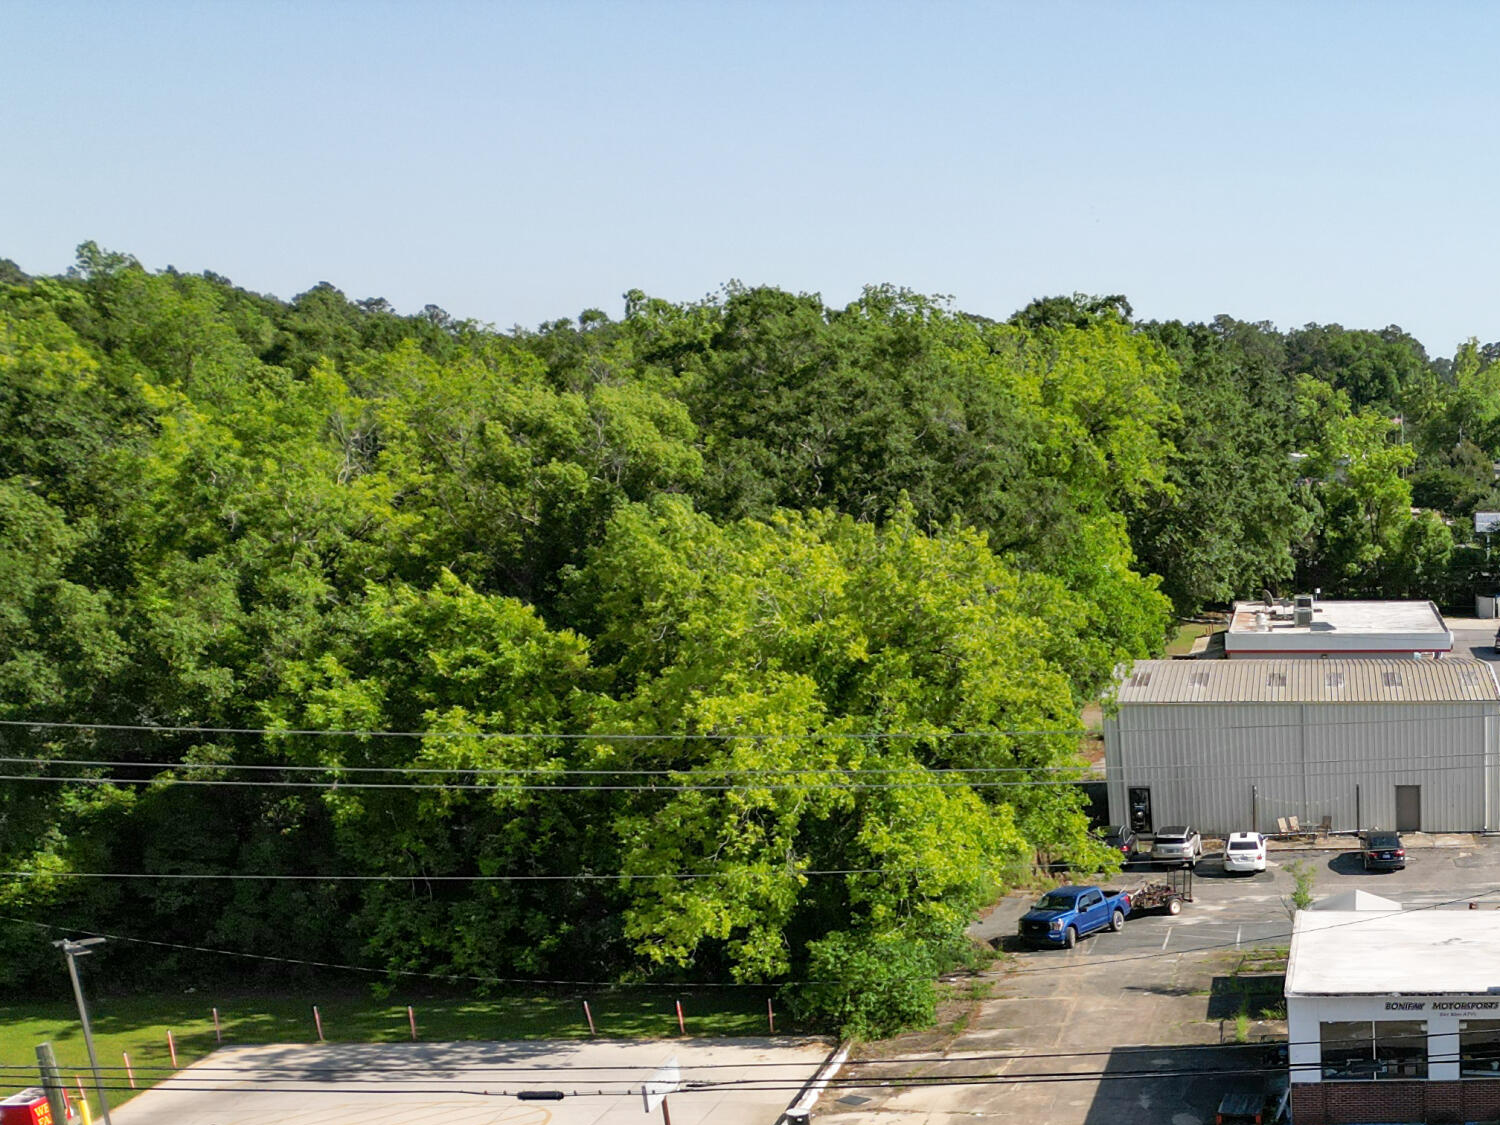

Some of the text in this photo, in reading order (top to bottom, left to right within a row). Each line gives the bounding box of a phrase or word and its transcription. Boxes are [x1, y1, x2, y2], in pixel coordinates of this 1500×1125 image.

[1384, 1001, 1499, 1011] BONIFAY MOTORSPORTS
[33, 1102, 50, 1117] WE
